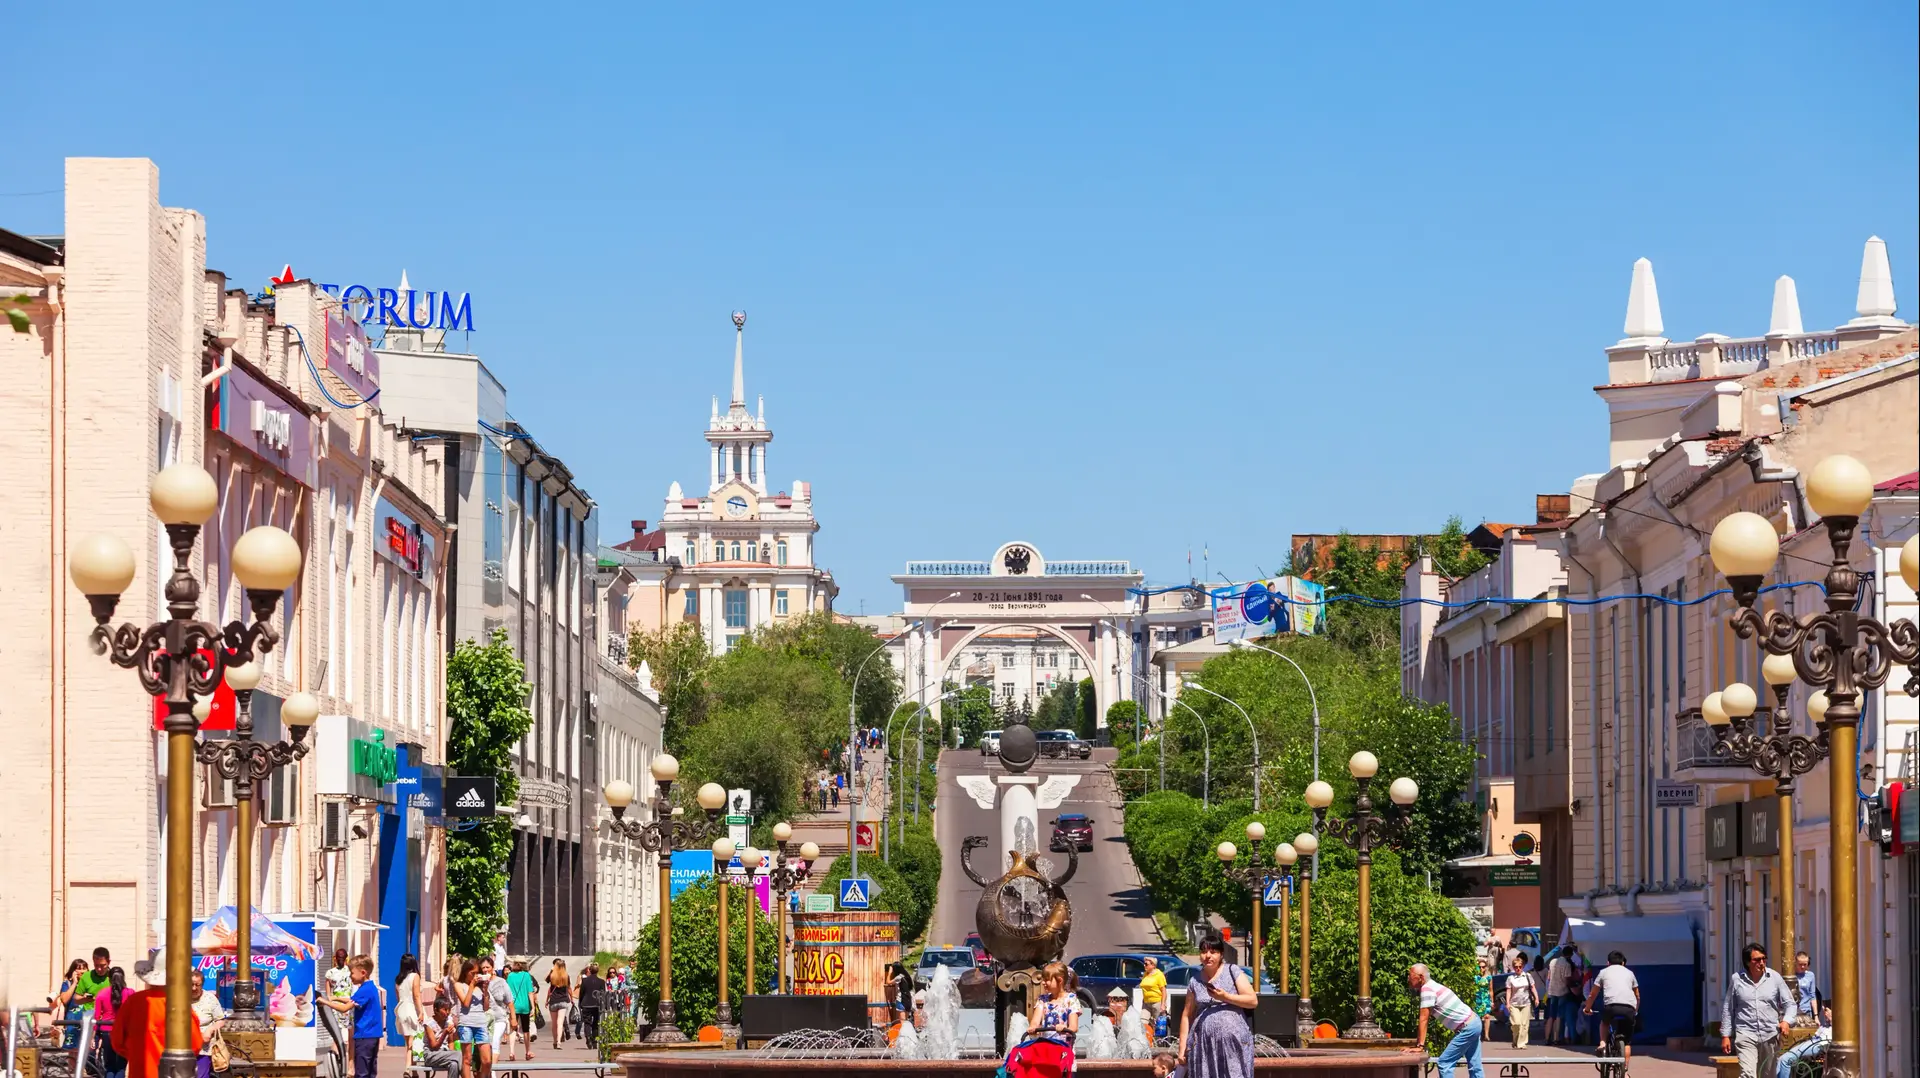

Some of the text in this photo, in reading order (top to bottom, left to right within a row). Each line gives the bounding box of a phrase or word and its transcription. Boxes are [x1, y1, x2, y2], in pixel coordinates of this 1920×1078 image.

[972, 592, 983, 602] 20
[990, 592, 1000, 602] 21
[1023, 592, 1042, 602] 1891
[1045, 593, 1063, 602] года
[396, 777, 418, 785] eebok
[455, 799, 485, 808] adidas
[670, 869, 712, 878] ЕКЛАМА
[794, 926, 840, 942] ЮБИМЫЙ
